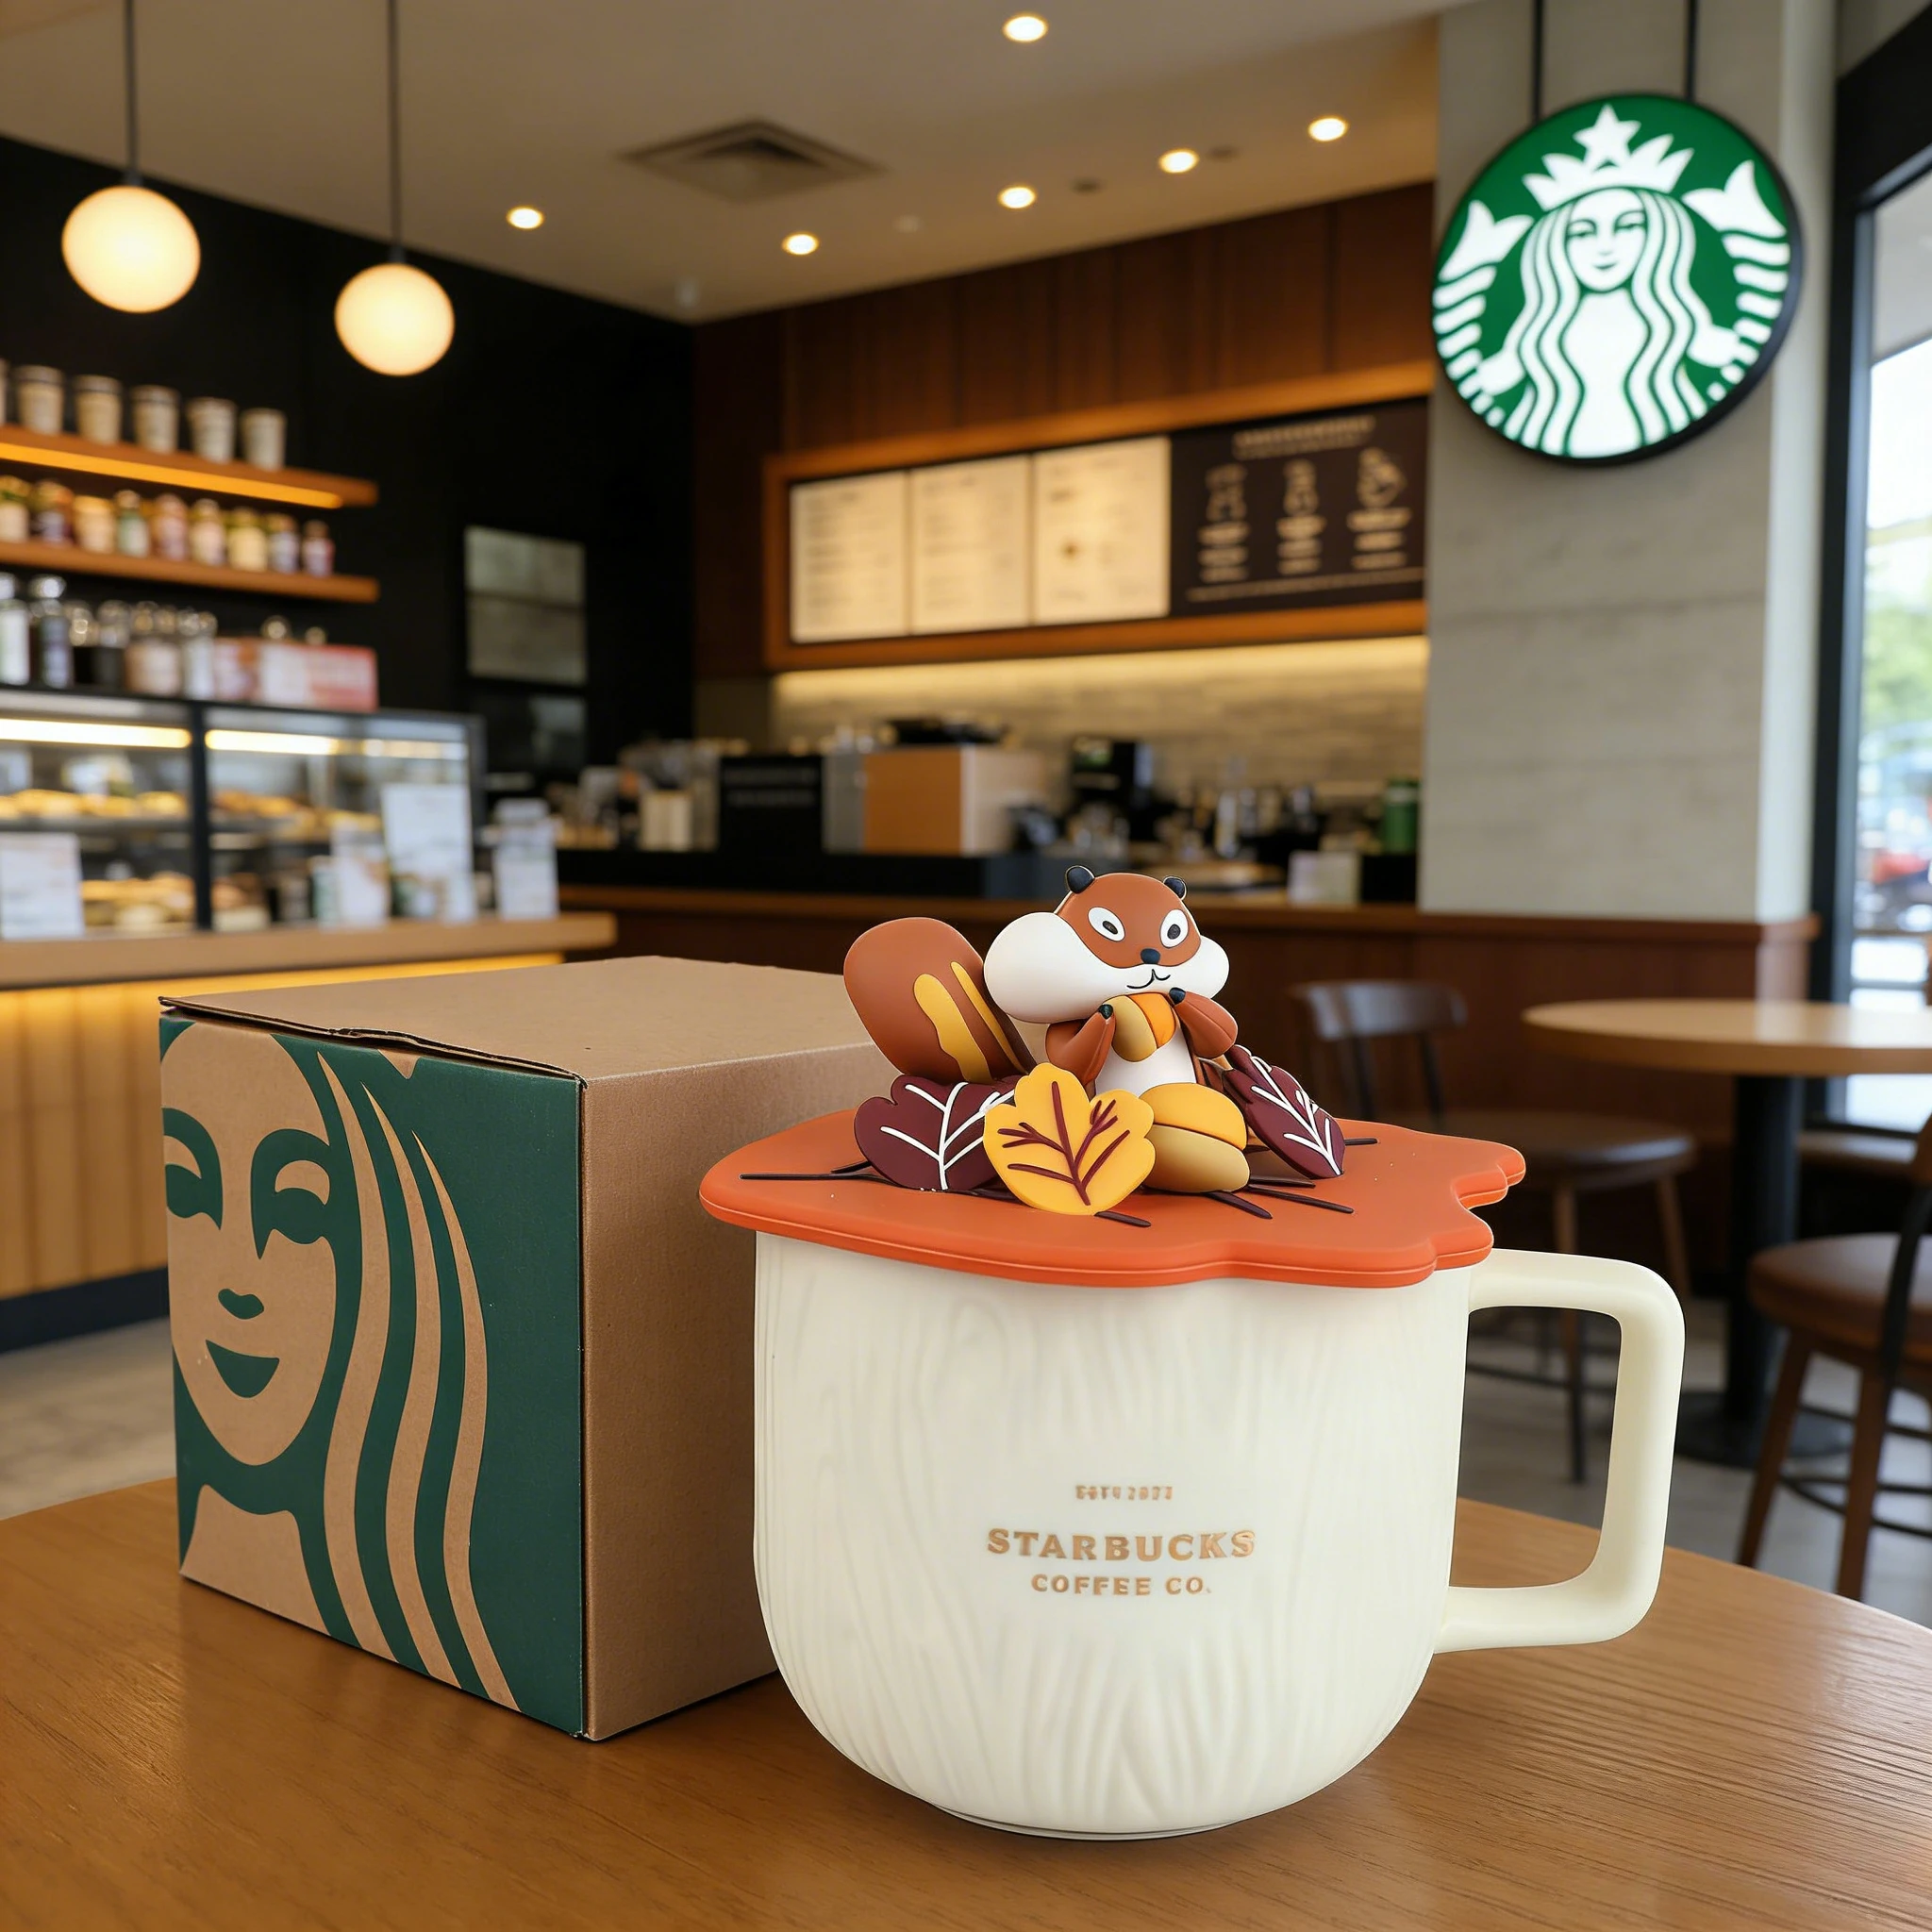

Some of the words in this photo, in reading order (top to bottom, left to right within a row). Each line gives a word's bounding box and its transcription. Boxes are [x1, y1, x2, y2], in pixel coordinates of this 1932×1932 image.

[986, 1527, 1256, 1562] STARBUCKS
[1031, 1574, 1151, 1596] COFFEE
[1164, 1575, 1211, 1596] CO.
